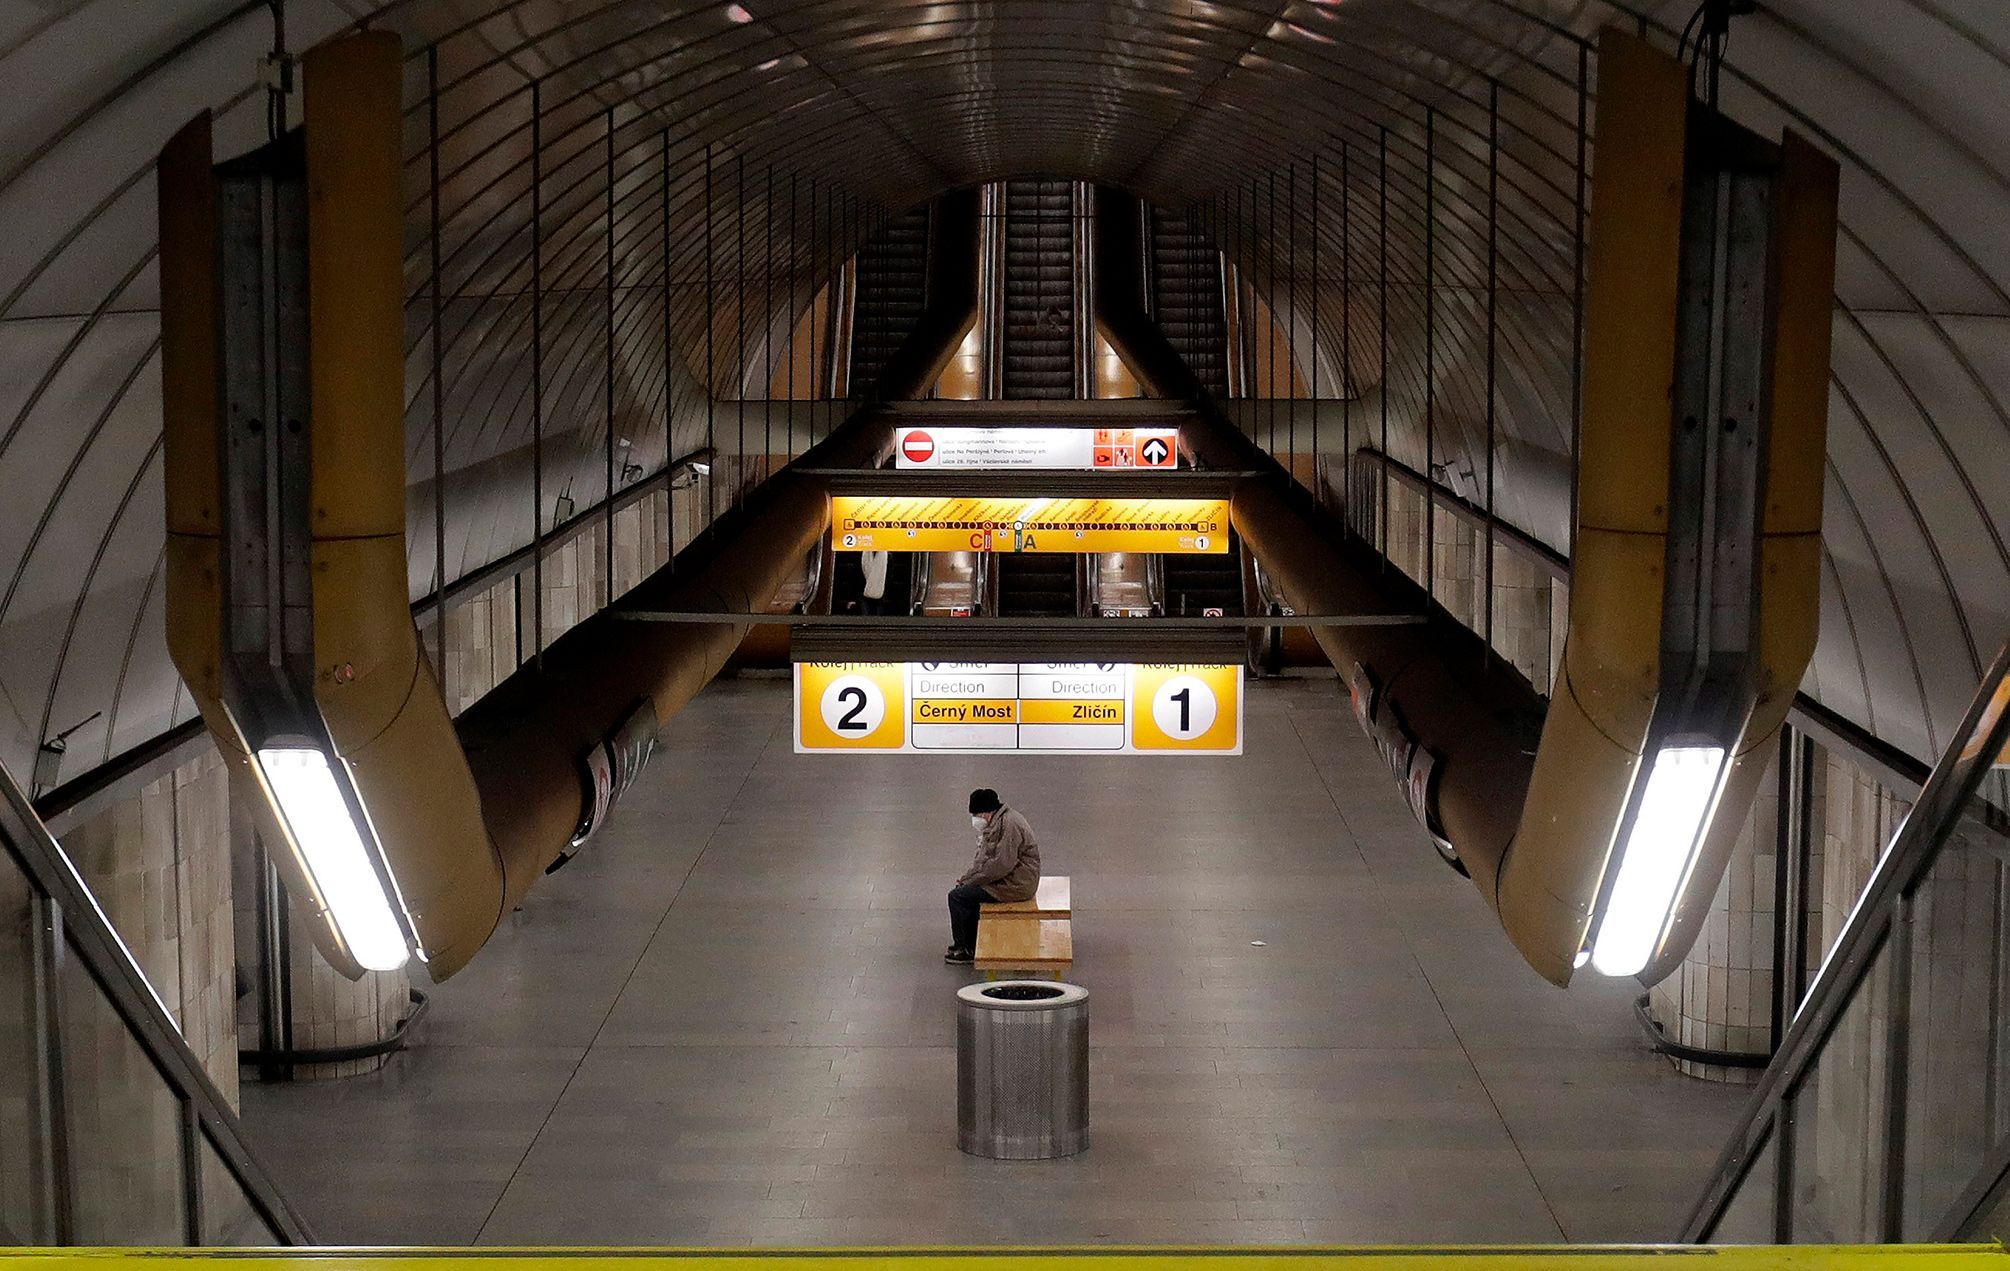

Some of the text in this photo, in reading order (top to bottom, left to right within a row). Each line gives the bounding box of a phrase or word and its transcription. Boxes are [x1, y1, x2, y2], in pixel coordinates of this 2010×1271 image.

[1210, 523, 1217, 531] B
[846, 535, 854, 546] 2
[970, 533, 983, 549] C
[1023, 534, 1037, 549] A
[1199, 538, 1204, 548] 1
[920, 680, 985, 693] Direction
[1052, 680, 1117, 694] Direction
[837, 686, 868, 730] 2
[920, 701, 1012, 721] Černý Most
[1072, 704, 1117, 718] Zličín
[1170, 688, 1190, 732] 1
